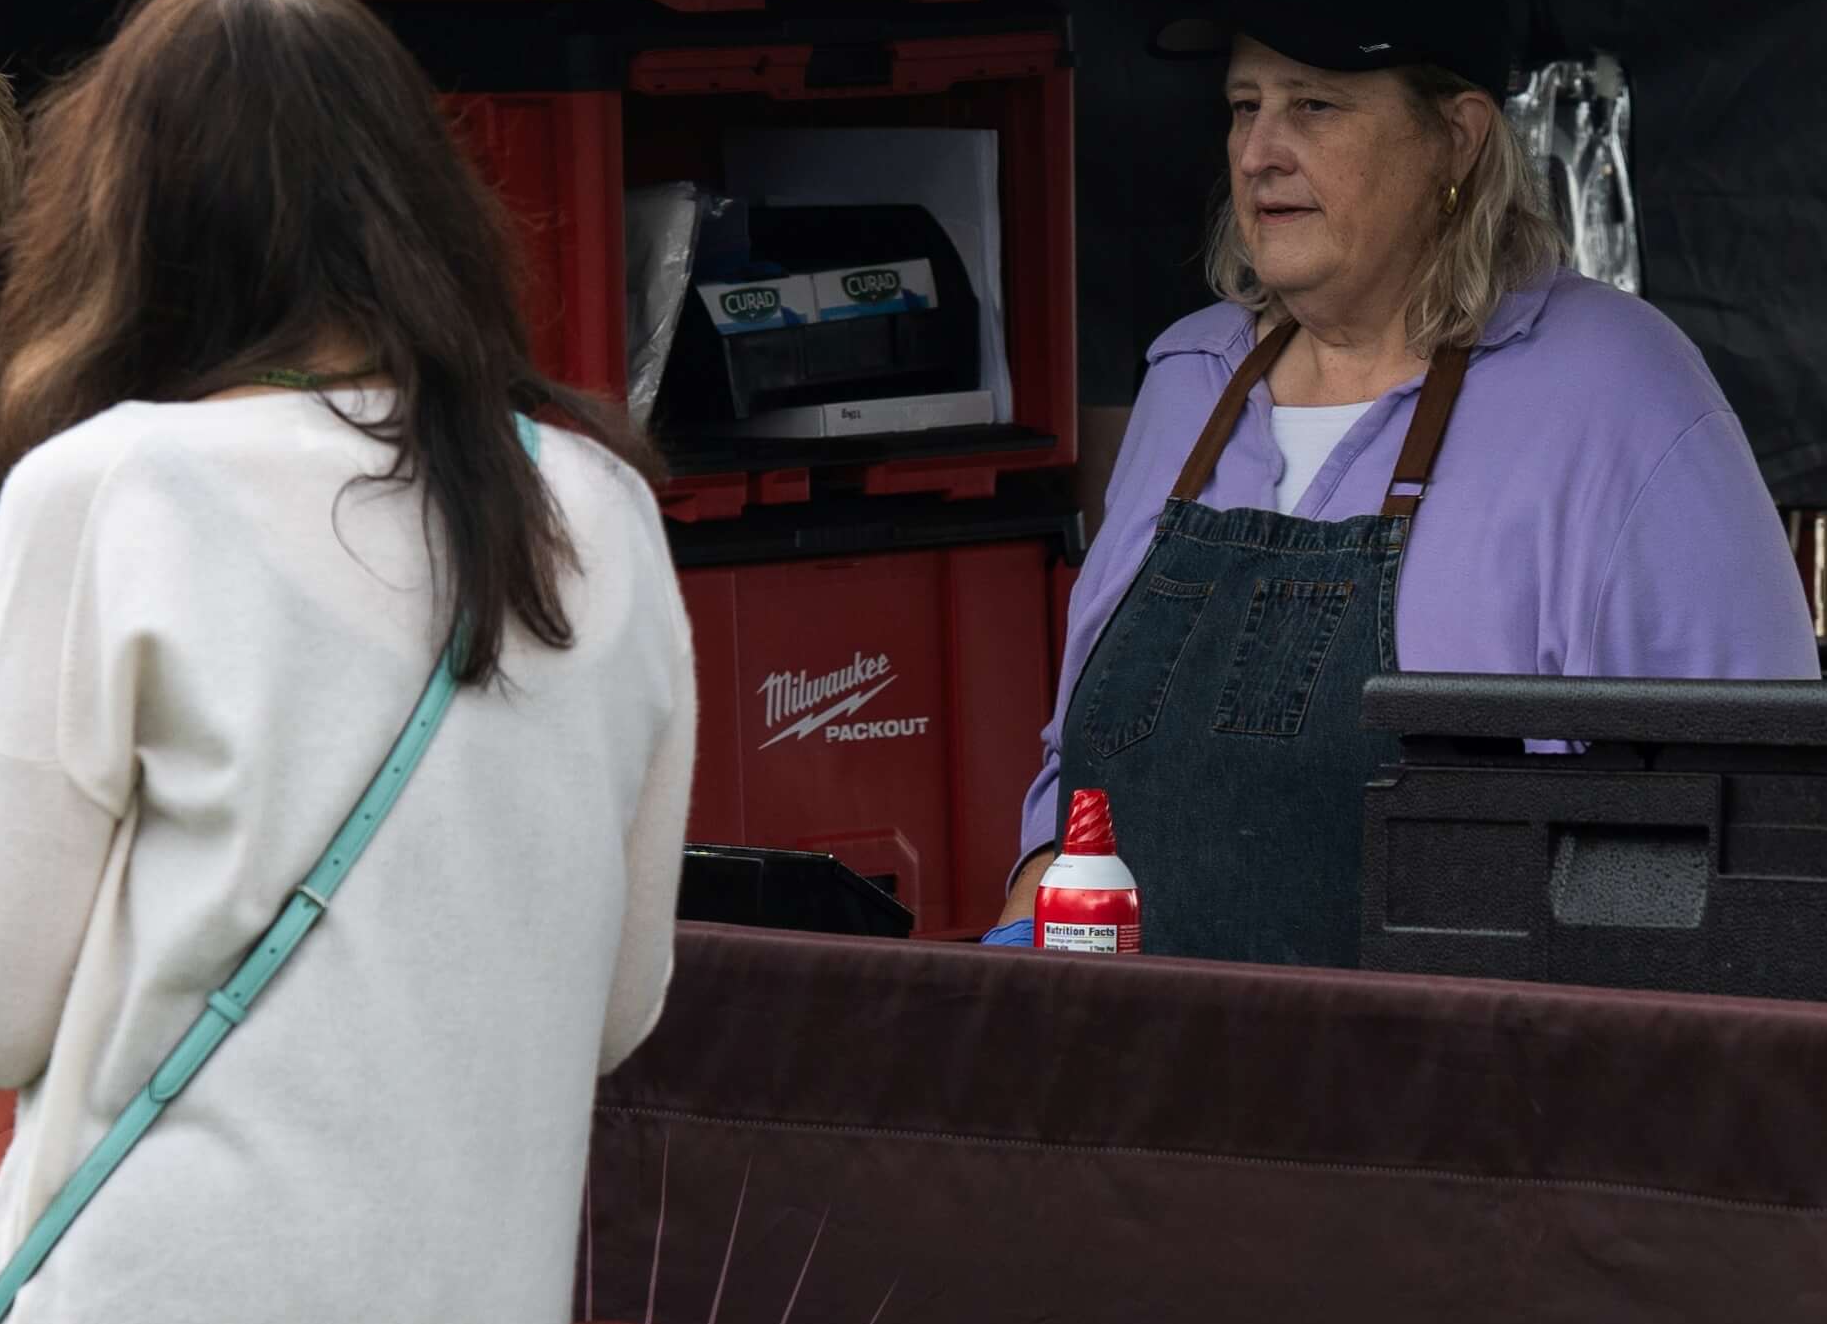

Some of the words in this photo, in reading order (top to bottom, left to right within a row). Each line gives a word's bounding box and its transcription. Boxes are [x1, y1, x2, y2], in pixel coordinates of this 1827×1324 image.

[847, 272, 899, 296] CURAD
[724, 290, 776, 315] CURAD
[757, 651, 892, 728] Milwaukee
[825, 716, 930, 742] PACKOUT
[1046, 925, 1085, 936] Nutrition
[1089, 927, 1115, 937] Facts
